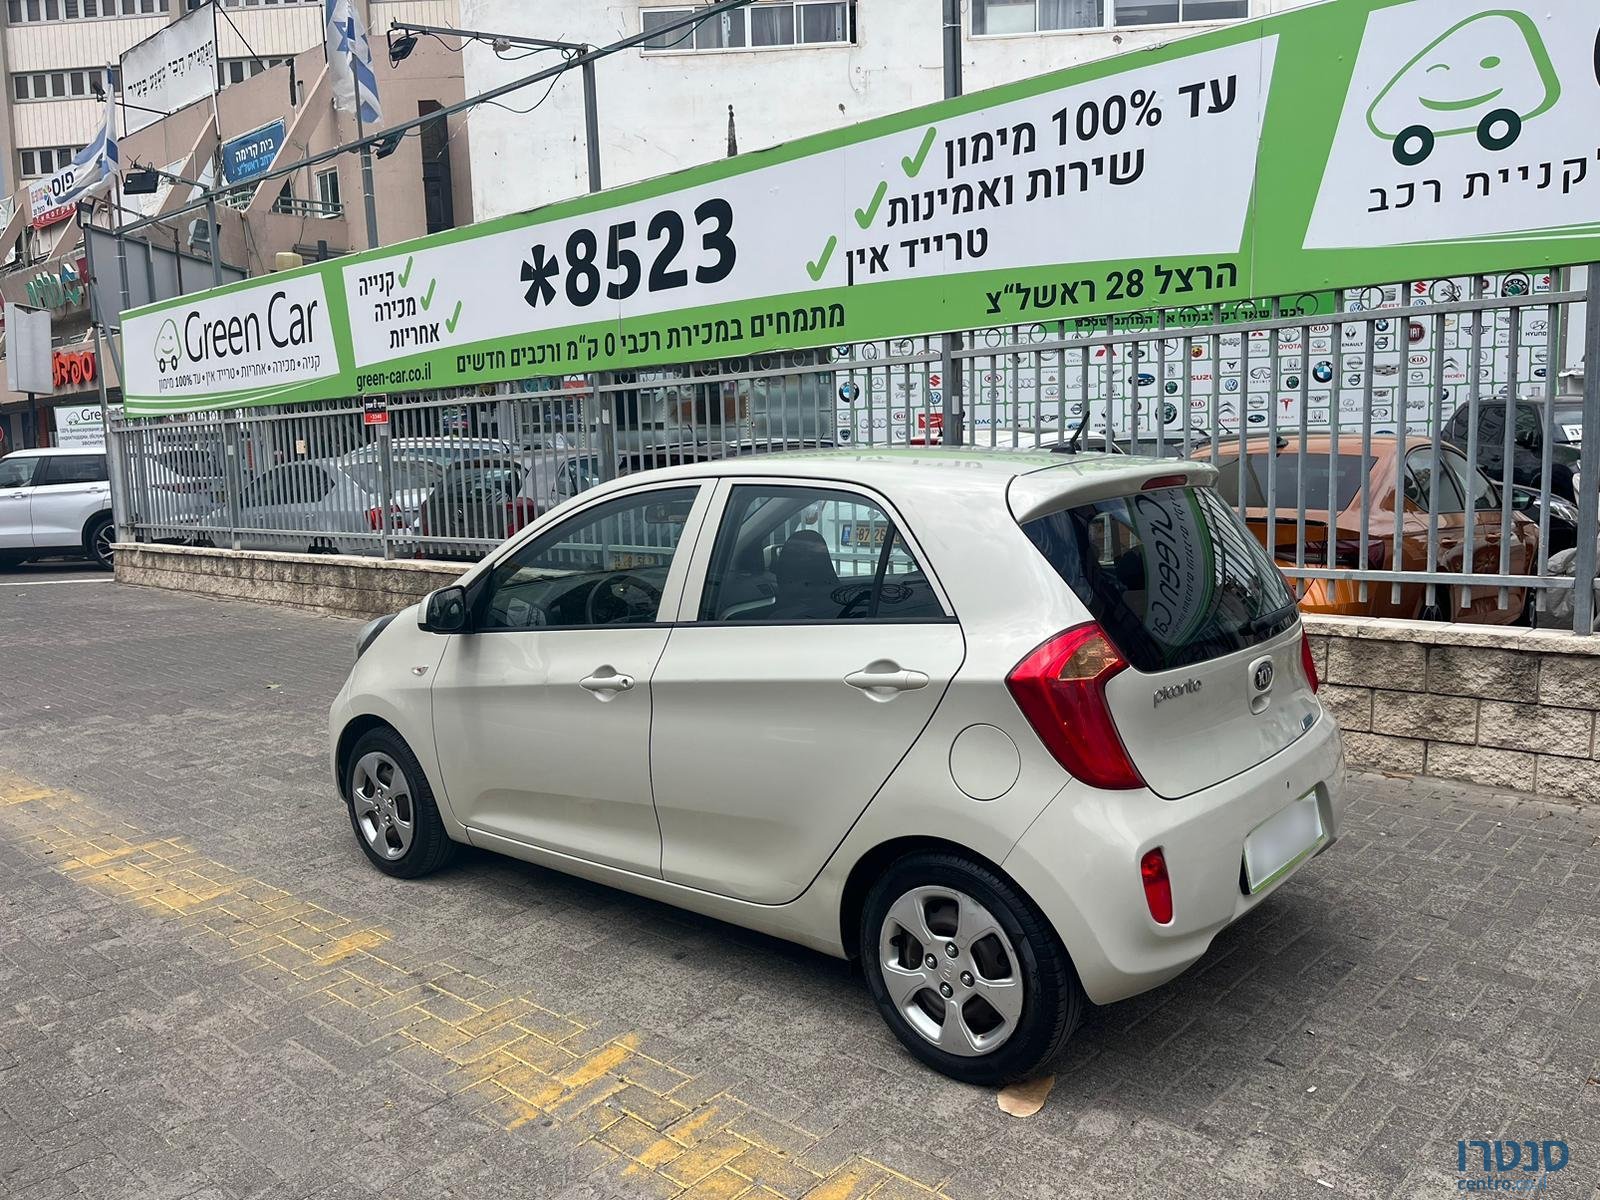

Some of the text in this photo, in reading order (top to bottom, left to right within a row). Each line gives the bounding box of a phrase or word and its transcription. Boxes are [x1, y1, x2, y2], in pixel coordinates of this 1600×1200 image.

[944, 74, 1237, 179] עד 100% מימון
[235, 138, 274, 163] בית קדימה
[887, 148, 1146, 228] שירות ואמינות
[1367, 148, 1600, 213] קניית רכב
[845, 226, 988, 287] טרייד אין
[358, 271, 395, 297] קנייה
[986, 261, 1238, 314] הרצל 28 ראשל"צ
[375, 296, 417, 323] מכירה
[749, 302, 846, 338] מתמחים
[184, 291, 318, 363] Green Car
[389, 323, 441, 349] אחריות
[667, 317, 743, 351] במכירת
[510, 342, 562, 366] ורכבים
[604, 336, 615, 358] 0
[620, 331, 661, 356] רכבי
[240, 363, 267, 378] אחריות
[272, 358, 296, 373] מכירה
[302, 355, 321, 372] קניה
[456, 350, 505, 373] חדשים
[175, 375, 193, 388] 100%
[193, 373, 201, 385] עד
[216, 368, 236, 382] טרייד
[356, 362, 432, 392] green-car.co.il
[1153, 677, 1202, 709] picanto
